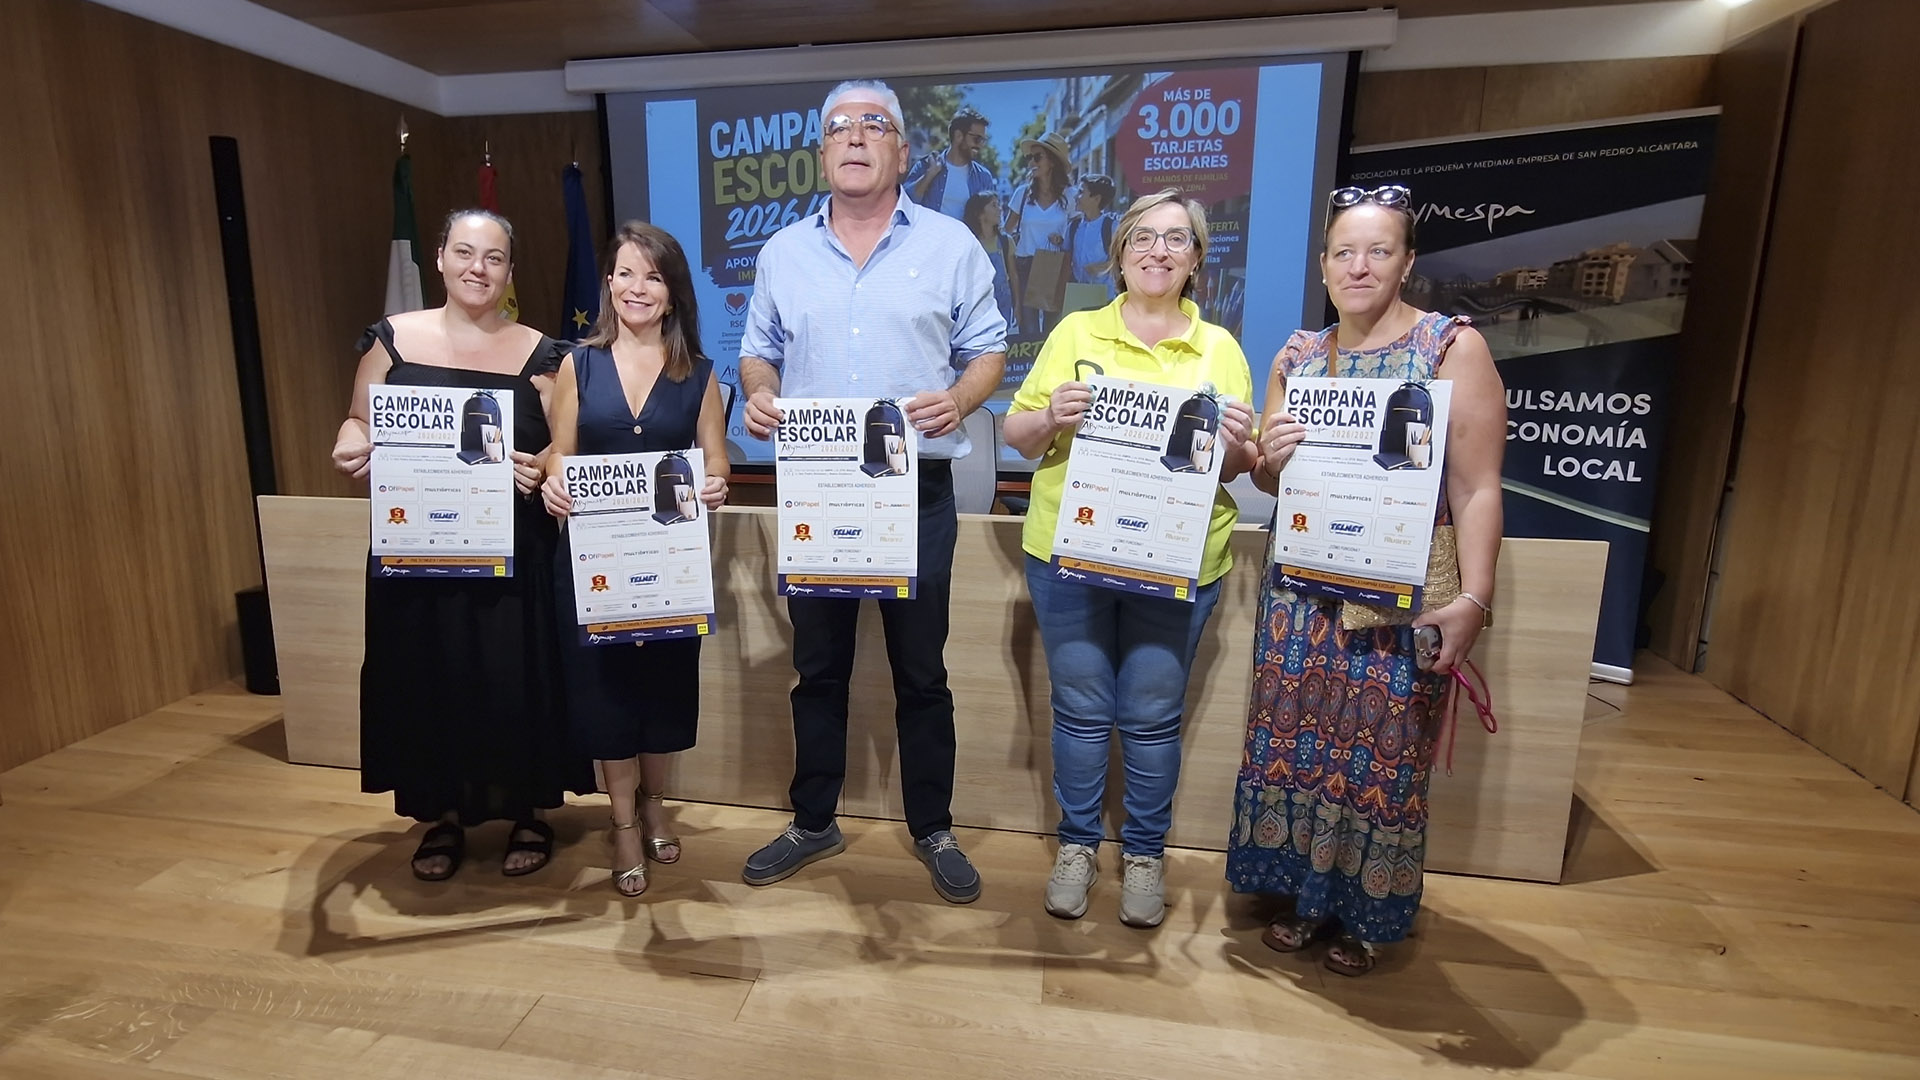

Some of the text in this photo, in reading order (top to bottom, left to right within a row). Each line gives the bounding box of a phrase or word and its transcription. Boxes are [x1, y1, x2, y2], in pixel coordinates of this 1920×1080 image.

[1164, 88, 1210, 102] MÁS DE
[1137, 100, 1240, 139] 3.000
[710, 109, 822, 158] CAMPA
[1152, 139, 1223, 154] TARJETAS
[1144, 155, 1228, 171] ESCOLARES
[1401, 168, 1412, 176] DE
[1414, 167, 1424, 175] LA
[1466, 162, 1472, 170] Y
[1474, 158, 1514, 168] MEDIANA
[1517, 154, 1560, 164] EMPRESA
[1562, 152, 1574, 161] DE
[1578, 150, 1596, 160] SAN
[1600, 147, 1634, 158] PEDRO
[1637, 141, 1698, 153] ALCÁNTARA
[713, 149, 831, 205] ESCOL
[1154, 174, 1180, 182] MANOS
[1183, 174, 1191, 182] DE
[1195, 172, 1228, 182] FAMILIAS
[373, 394, 454, 413] CAMPAÑA
[1288, 386, 1379, 409] CAMPAÑA
[1506, 389, 1651, 415] ULSAMOS
[373, 412, 455, 430] ESCOLAR
[778, 426, 857, 442] ESCOLAR
[1123, 429, 1164, 442] 2026/2027
[1331, 430, 1374, 439] 2026/2027
[1506, 420, 1647, 448] CONOMÍA
[566, 460, 646, 483] CAMPAÑA
[1321, 471, 1363, 479] ESTABLECIMIENTOS
[1543, 455, 1642, 482] LOCAL
[568, 478, 648, 499] ESCOLAR
[1081, 483, 1109, 493] OfiPapel
[1293, 489, 1320, 497] OfiPapel
[1330, 493, 1372, 502] multiópticas
[430, 512, 458, 520] TELNET
[1117, 517, 1148, 529] TELNET
[833, 528, 862, 537] TELNET
[1330, 522, 1364, 533] TELNET
[630, 574, 658, 583] TELNET
